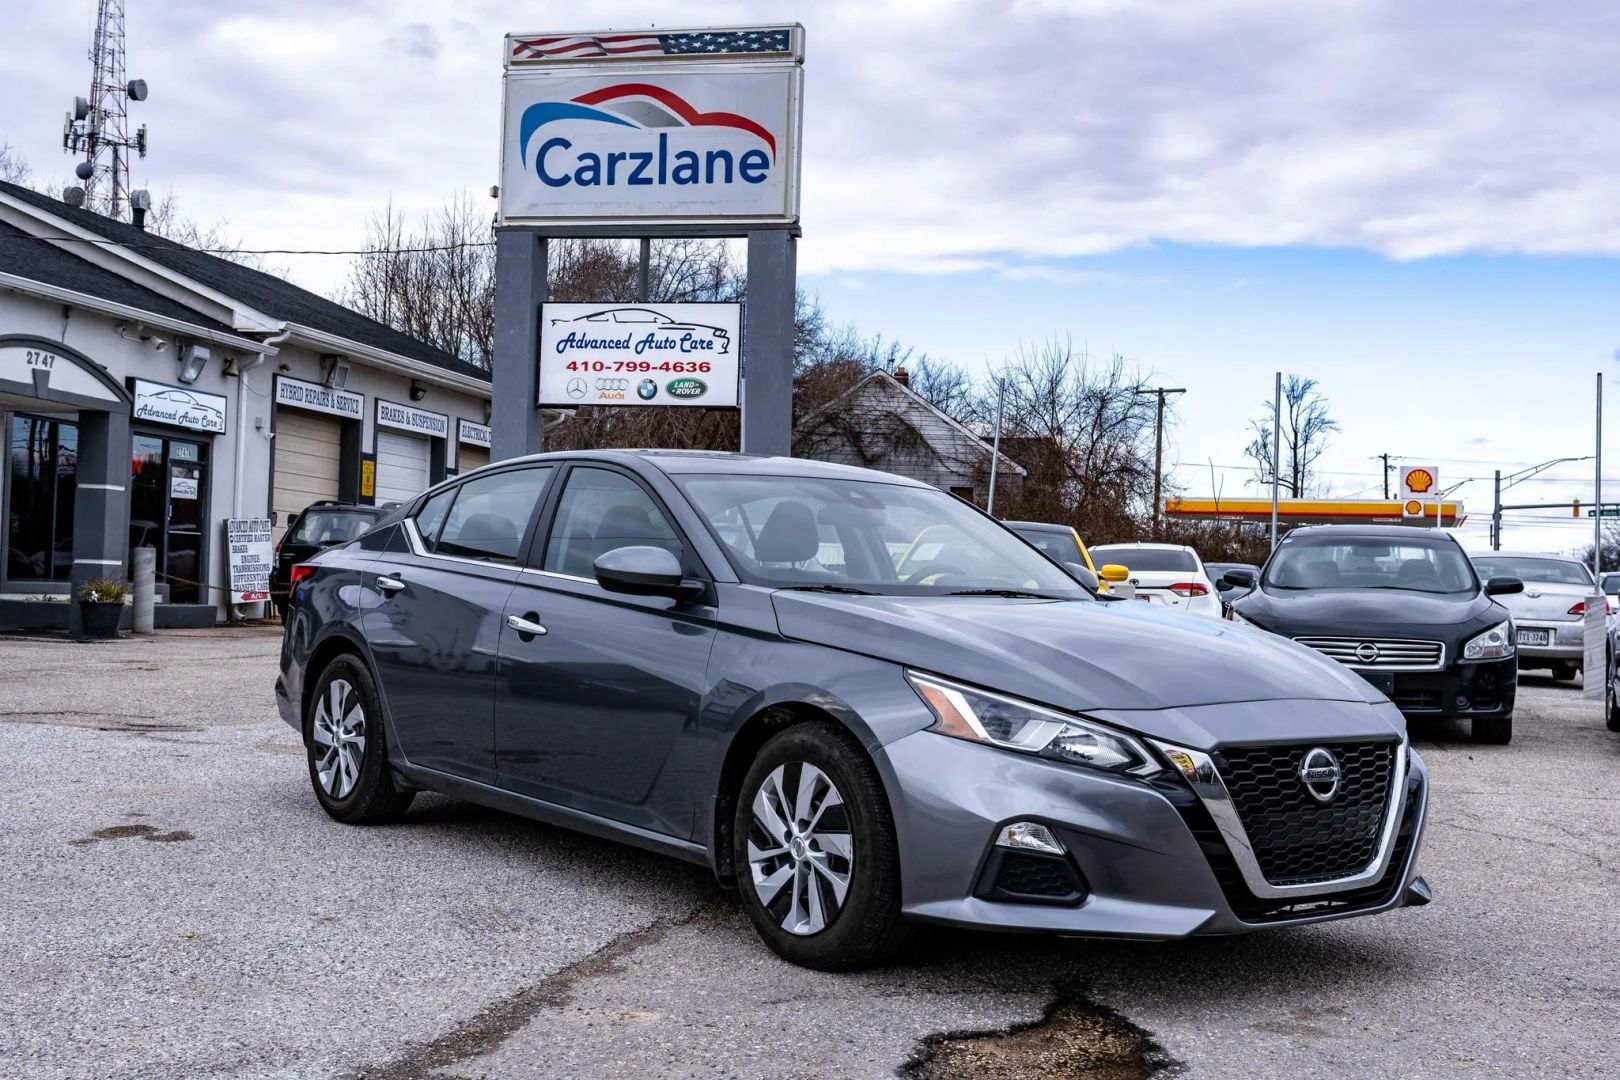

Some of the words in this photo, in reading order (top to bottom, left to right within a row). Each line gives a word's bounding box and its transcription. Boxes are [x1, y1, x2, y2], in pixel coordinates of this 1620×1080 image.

[535, 132, 770, 187] Carzlane
[556, 332, 632, 354] Advanced
[635, 333, 676, 354] Auto
[680, 333, 714, 352] Care
[26, 350, 55, 368] 2747
[566, 361, 711, 373] 410-799-4636
[280, 382, 304, 402] HYBRID
[304, 388, 330, 408] REPAIRS
[331, 393, 336, 409] &
[336, 395, 360, 414] SERVICE
[599, 392, 625, 400] Audi
[136, 404, 178, 420] Advanced
[178, 411, 200, 424] Auto
[201, 414, 218, 428] Care
[381, 406, 405, 424] BRAKES
[406, 411, 411, 425] &
[412, 413, 445, 432] SUSPENSION
[462, 424, 488, 442] ELECTRICAL
[234, 534, 253, 543] CERTIFIED
[253, 534, 270, 542] MASTER
[232, 545, 248, 554] BRAKES
[241, 555, 260, 563] ENGINES
[233, 564, 270, 573] TRANSMISSIONS
[1307, 768, 1336, 779] NISSAN
